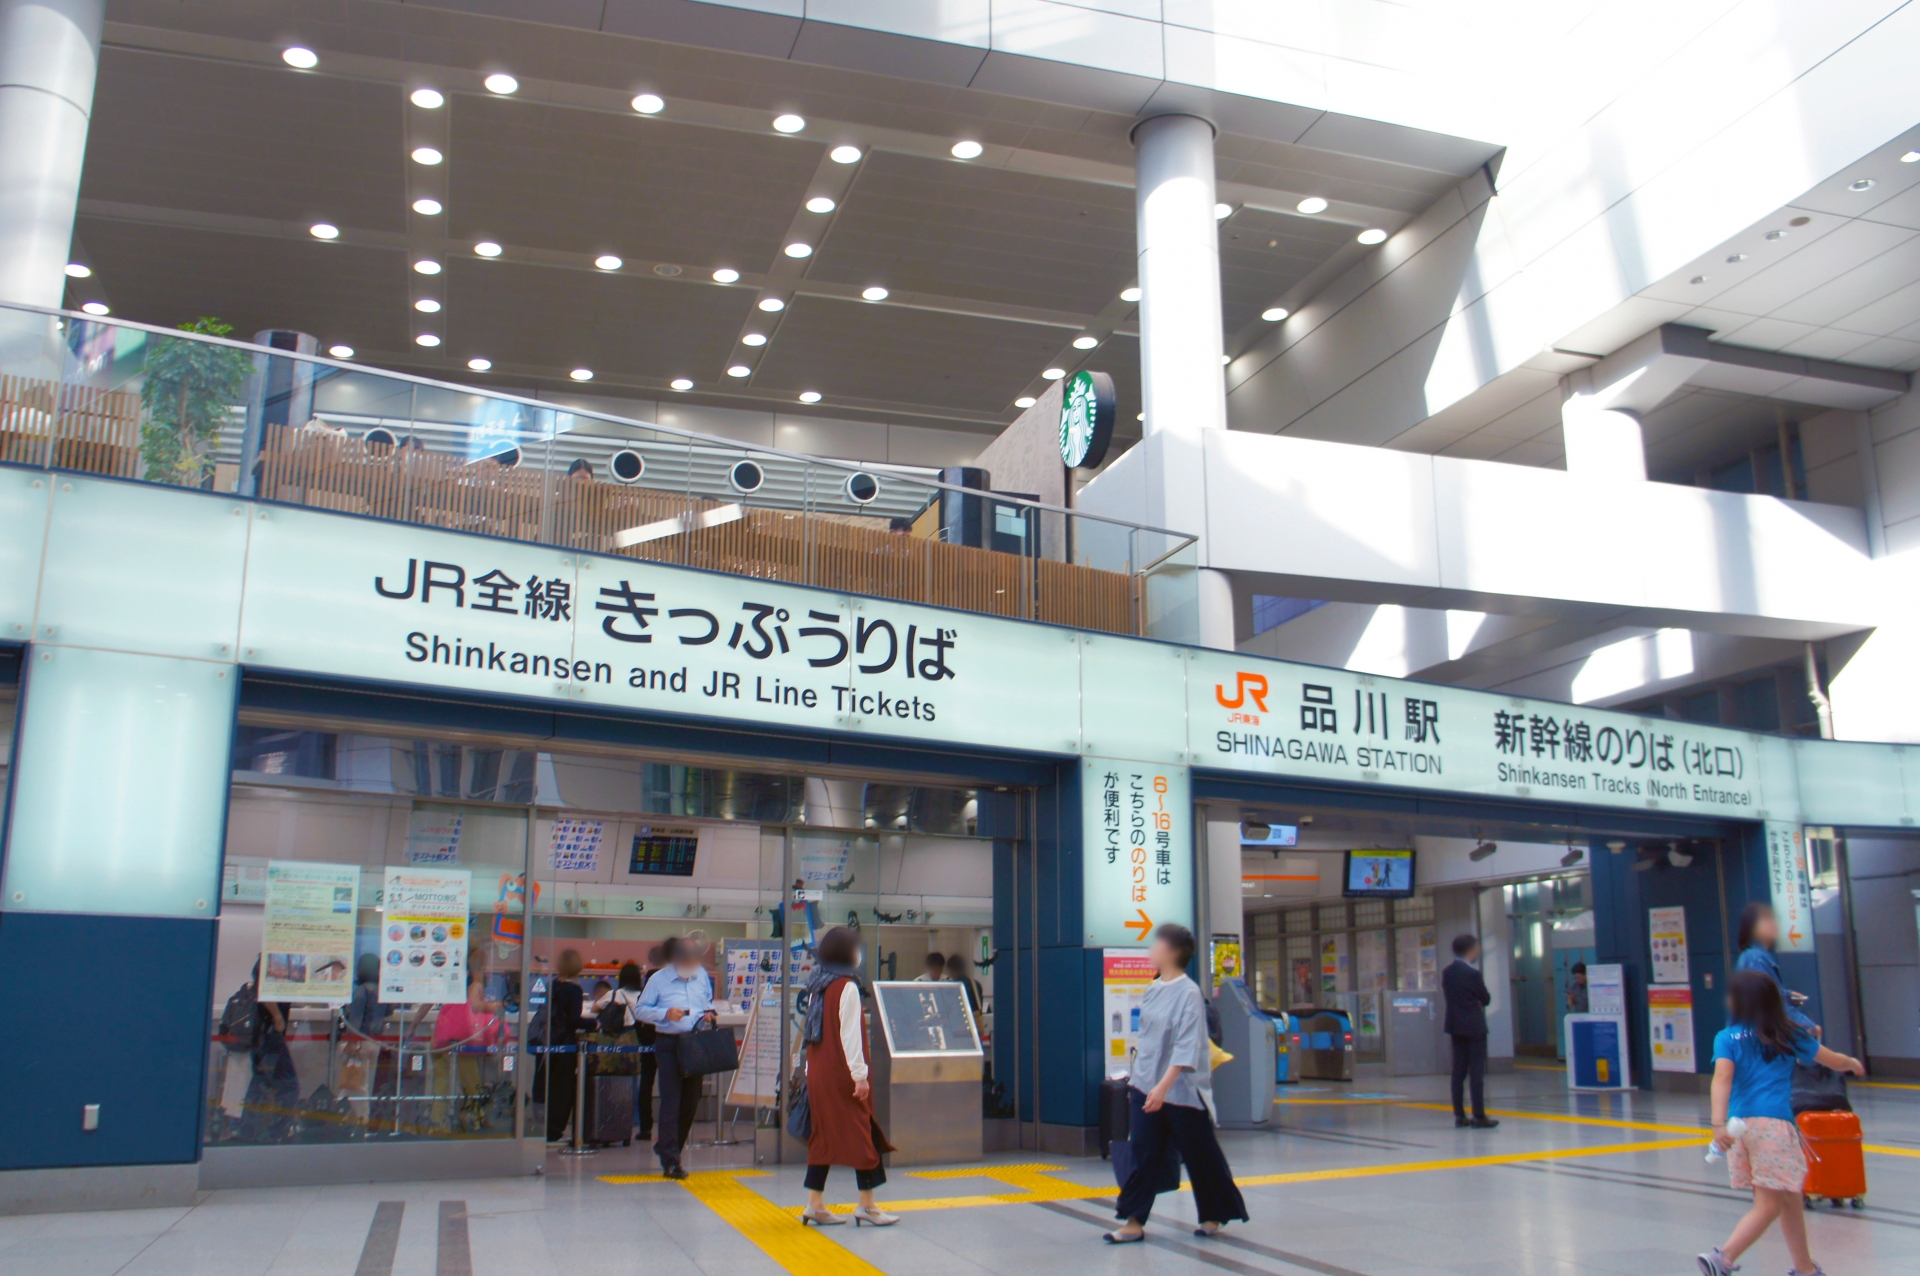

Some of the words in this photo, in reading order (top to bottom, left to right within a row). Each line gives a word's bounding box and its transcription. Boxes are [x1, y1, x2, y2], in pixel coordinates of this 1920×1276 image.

[374, 557, 573, 622] JR全線
[594, 579, 958, 682] きっぷうりば
[405, 630, 613, 685] Shinkansen
[628, 665, 687, 693] and
[702, 670, 741, 700] JR
[756, 675, 818, 709] Line
[830, 685, 937, 723] Tickets
[1215, 671, 1269, 713] JR
[1299, 682, 1442, 745] 品川駅
[1216, 730, 1348, 765] SHINAGAWA
[1357, 746, 1442, 775] STATION
[1497, 762, 1586, 790] Shinkansen
[1593, 773, 1640, 795] Tracks
[1647, 779, 1688, 800] (North
[1692, 784, 1752, 807] Entrance)
[1103, 771, 1121, 865] が便利です
[1130, 773, 1148, 903] こちらののりば
[635, 900, 644, 912] 3
